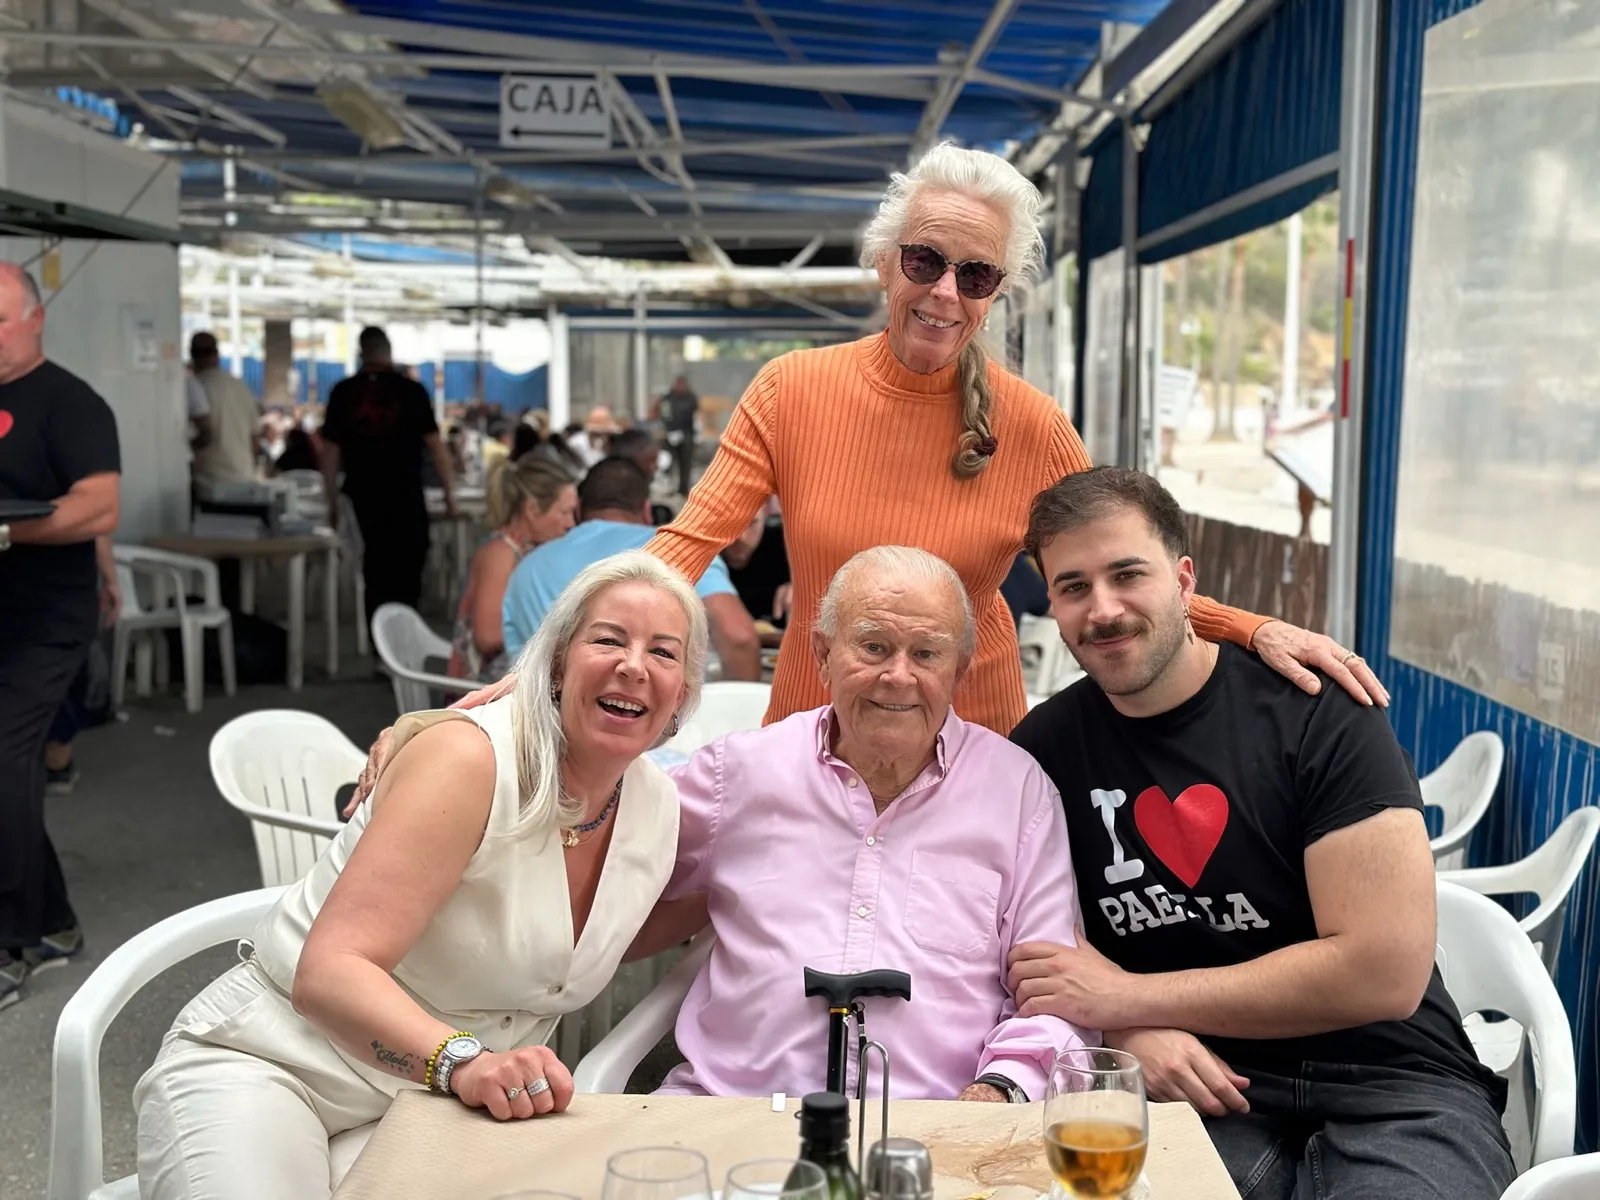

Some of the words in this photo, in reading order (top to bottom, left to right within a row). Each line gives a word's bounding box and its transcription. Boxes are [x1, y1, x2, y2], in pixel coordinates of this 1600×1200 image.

[508, 83, 605, 114] CAJA
[1090, 788, 1144, 885] I
[1098, 884, 1270, 937] PAELA
